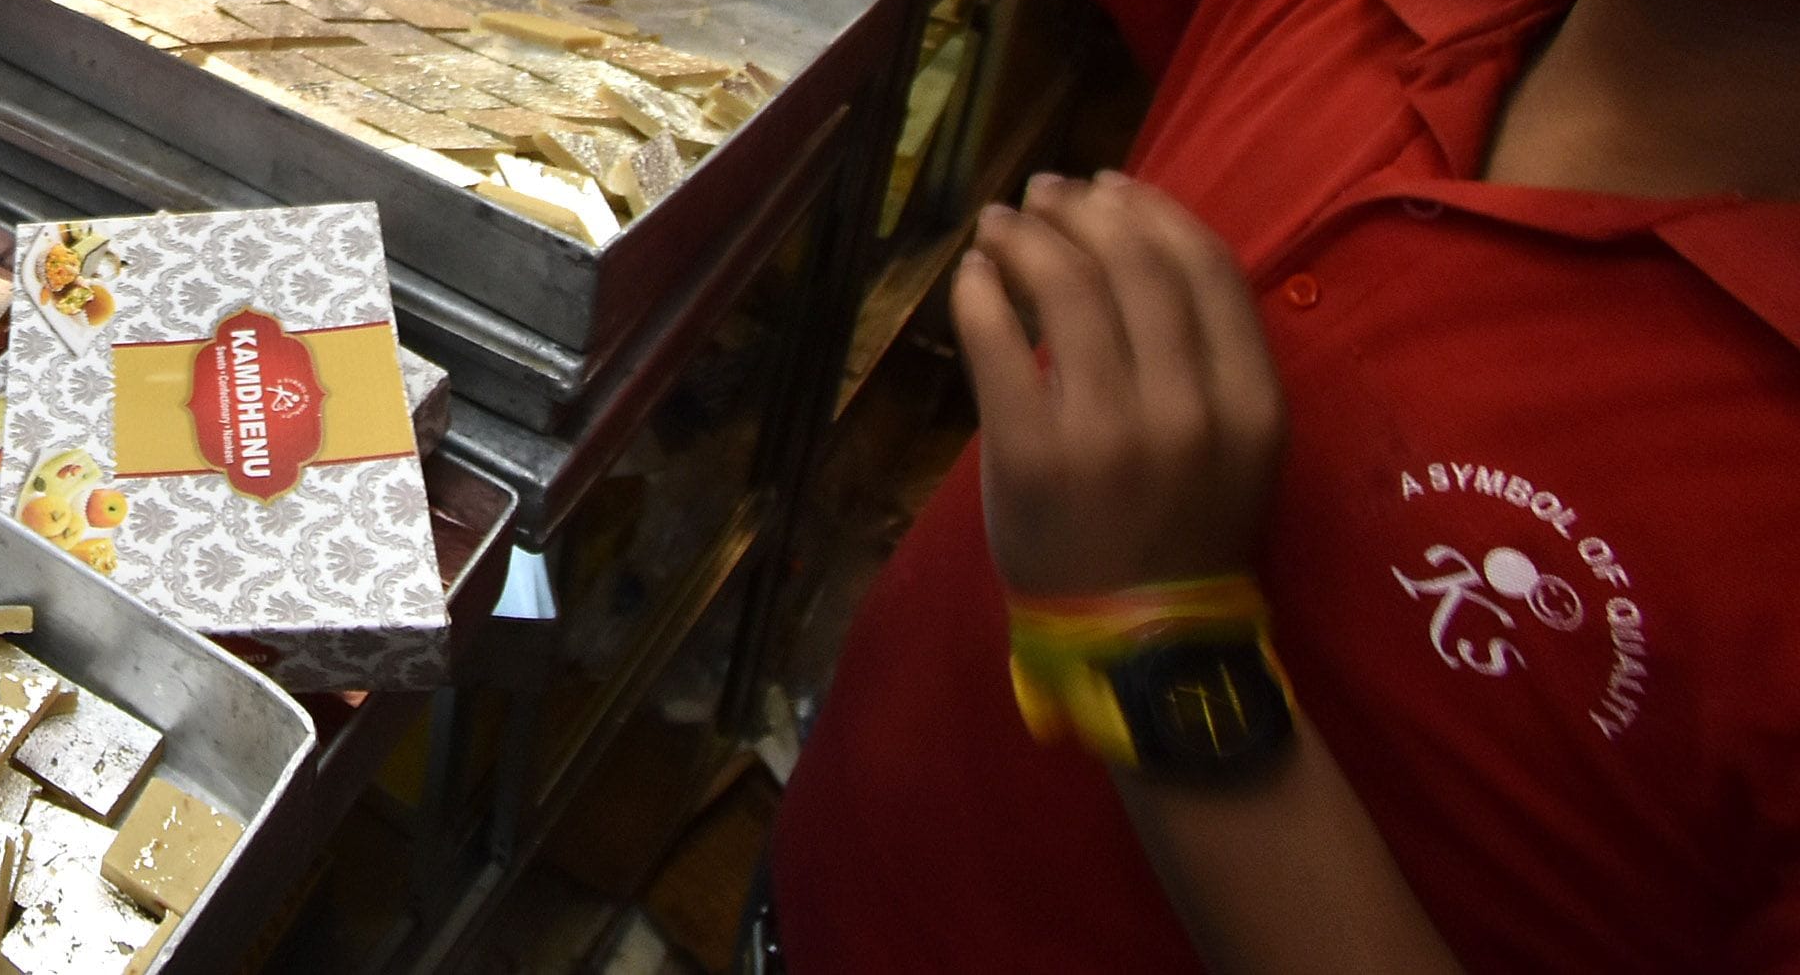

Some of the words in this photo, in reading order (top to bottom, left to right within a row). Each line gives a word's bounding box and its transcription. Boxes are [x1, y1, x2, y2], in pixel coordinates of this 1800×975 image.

[215, 345, 227, 370] Sweets
[230, 329, 271, 477] KAMDHENU
[1401, 470, 1425, 502] A
[1427, 462, 1579, 541] SYMBOL
[1577, 536, 1631, 588] OF
[1588, 596, 1648, 741] QUALITY
